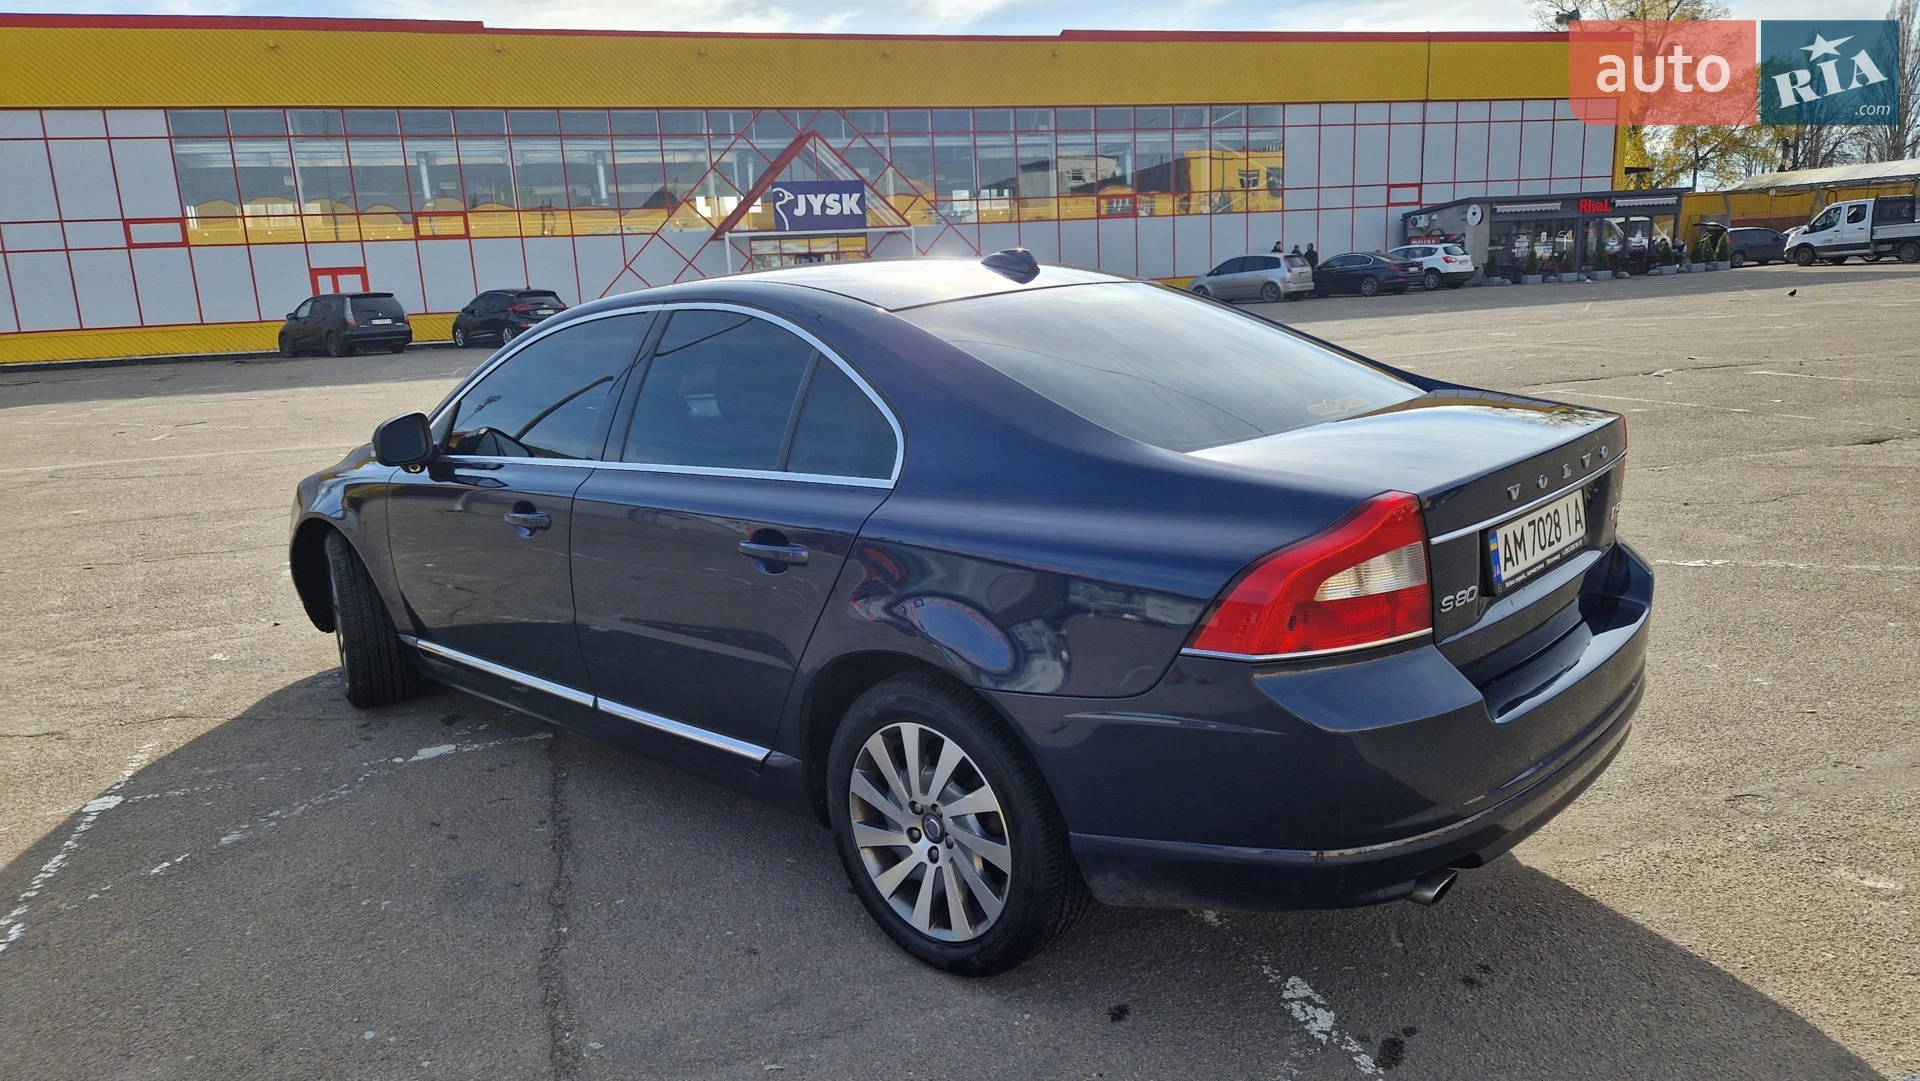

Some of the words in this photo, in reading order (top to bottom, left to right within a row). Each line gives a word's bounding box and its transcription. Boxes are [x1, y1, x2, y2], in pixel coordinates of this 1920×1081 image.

[793, 193, 863, 216] JYSK
[1507, 445, 1608, 500] VOLVO
[1503, 525, 1528, 572] AM
[1528, 508, 1562, 556] 7028
[1440, 585, 1478, 613] S80
